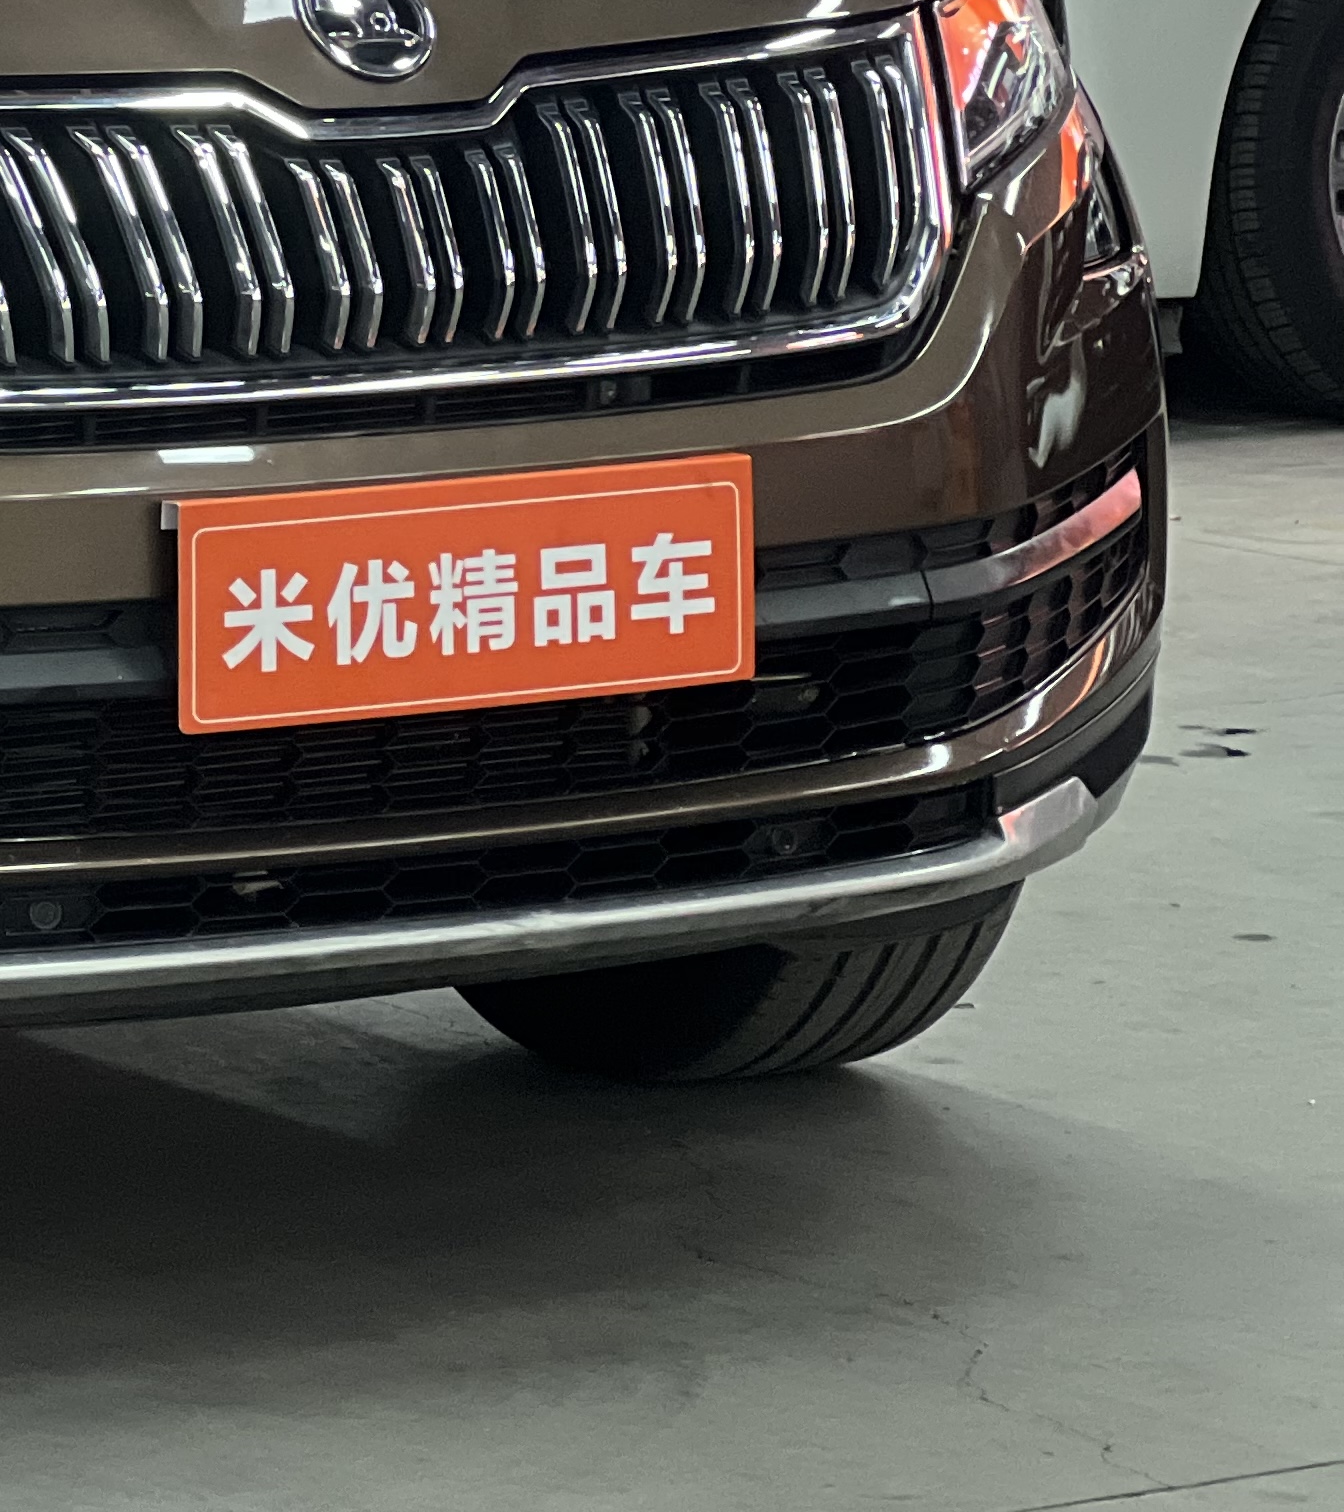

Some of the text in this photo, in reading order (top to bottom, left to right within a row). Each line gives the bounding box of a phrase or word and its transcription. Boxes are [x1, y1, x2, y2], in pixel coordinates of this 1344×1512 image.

[220, 531, 716, 674] 米优精品车
